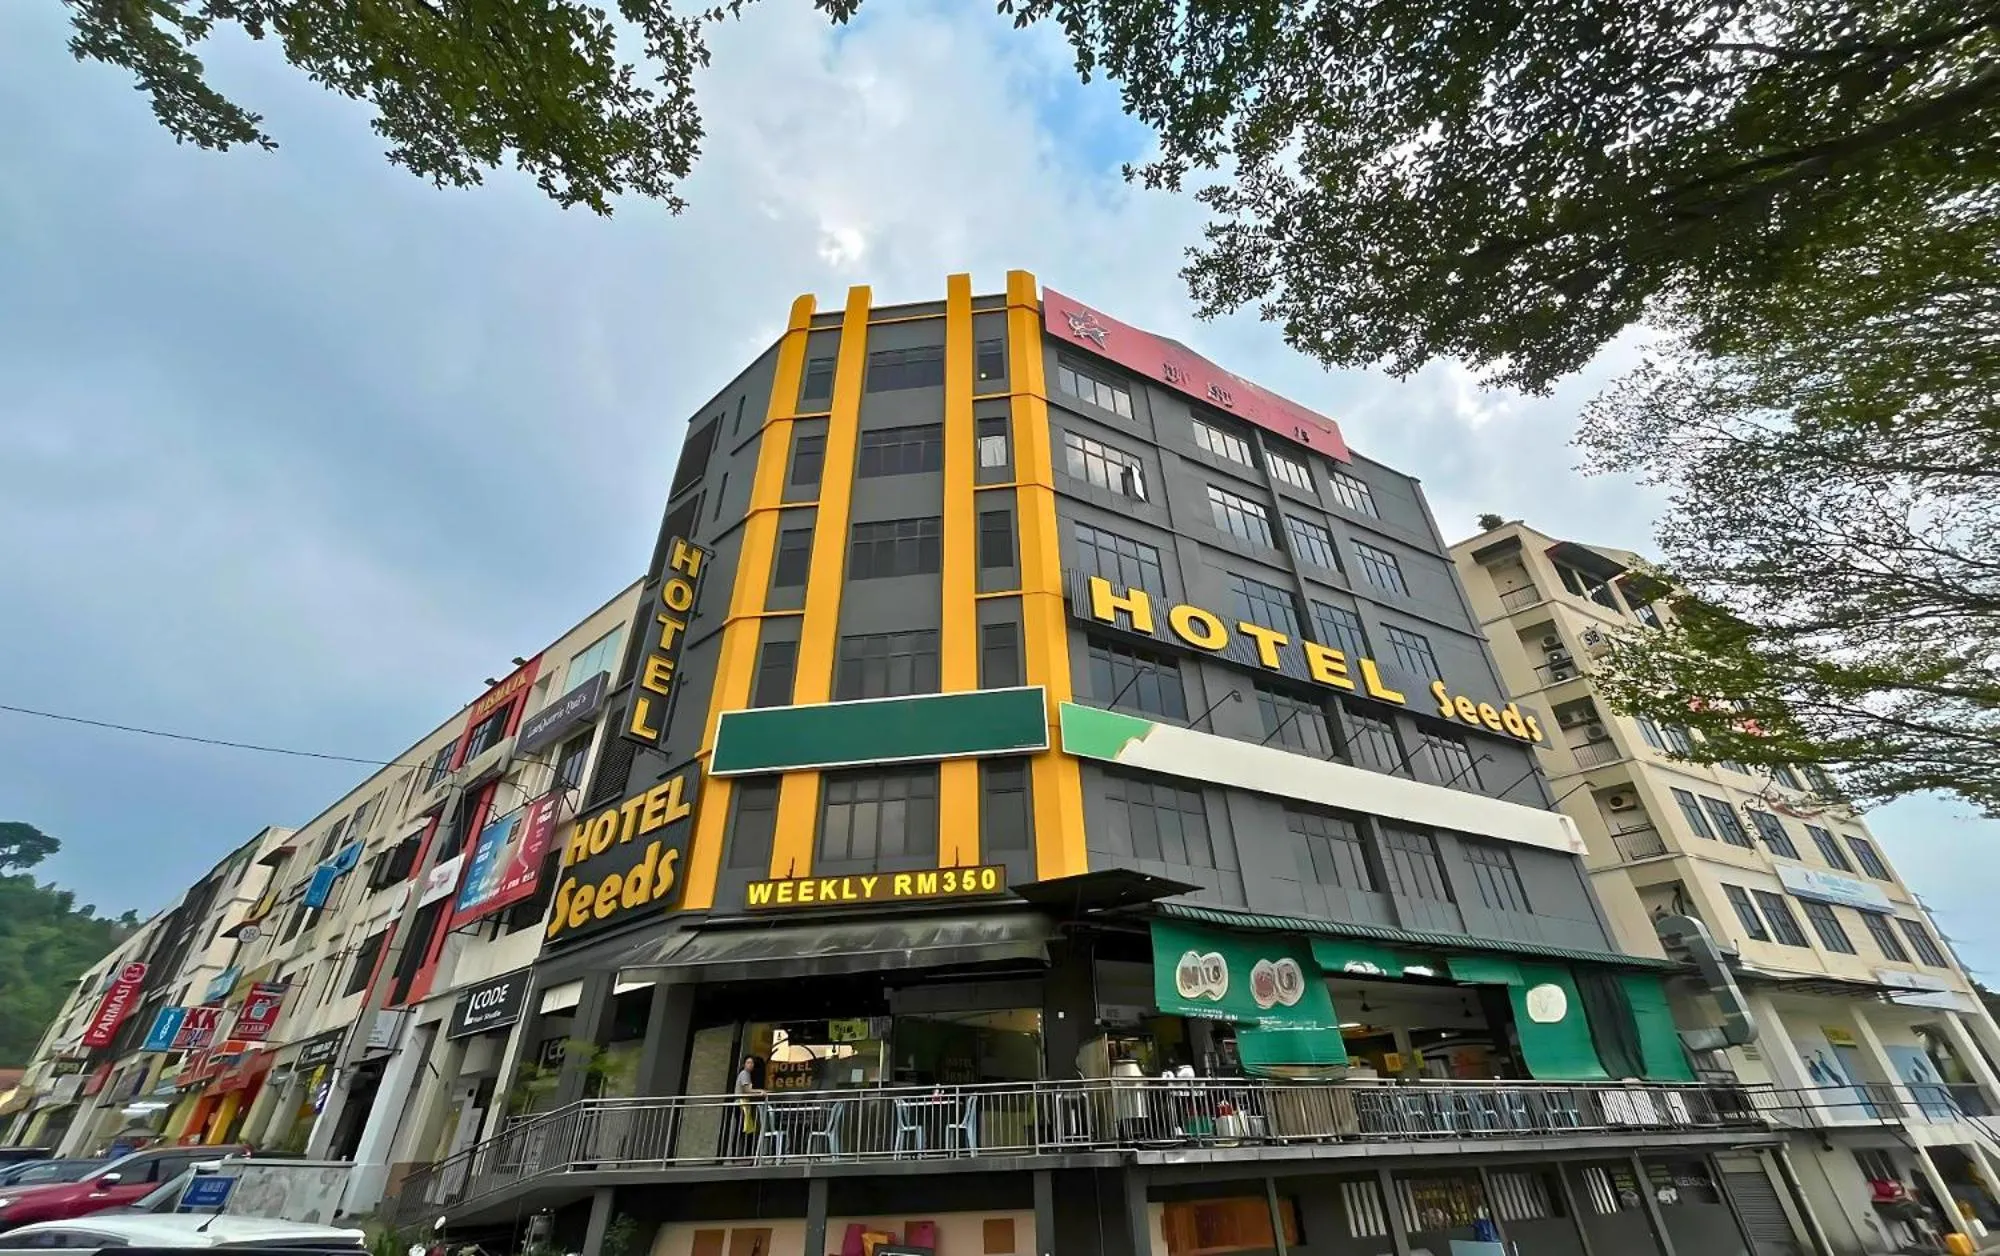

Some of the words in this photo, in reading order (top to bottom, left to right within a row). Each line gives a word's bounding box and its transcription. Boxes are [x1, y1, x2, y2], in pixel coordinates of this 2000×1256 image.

[630, 539, 702, 740] HOTEL
[1088, 575, 1406, 704] HOTEL
[1429, 680, 1543, 742] Seeds
[564, 775, 691, 867] HOTEL
[548, 841, 679, 938] Seeds
[748, 876, 879, 905] WEEKLY
[894, 869, 997, 896] RM350
[92, 984, 133, 1039] FARMASI
